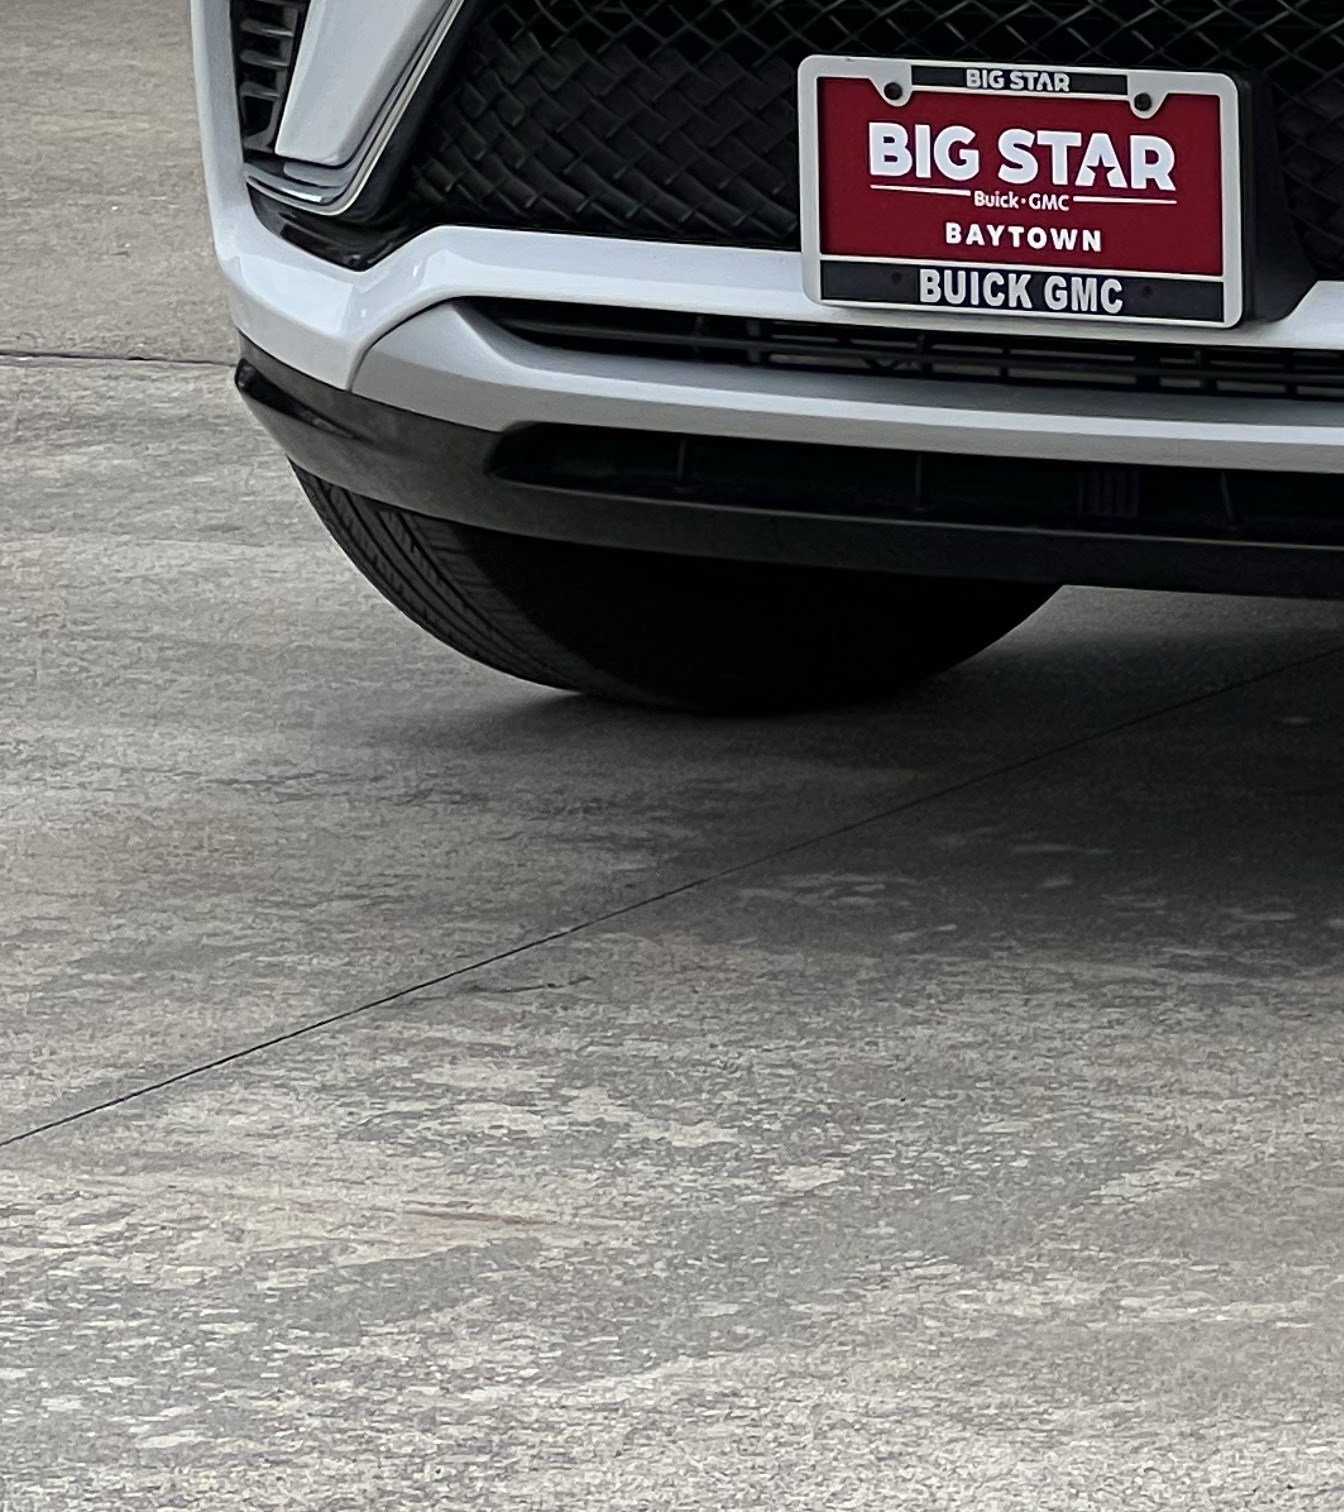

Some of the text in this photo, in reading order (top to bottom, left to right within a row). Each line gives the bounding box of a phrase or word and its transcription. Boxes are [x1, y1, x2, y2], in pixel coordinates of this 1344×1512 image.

[966, 68, 1070, 93] BIG STAR
[868, 121, 1177, 191] BIG STAR
[974, 191, 1070, 212] Buick GMC
[945, 222, 1102, 253] BAYTOWN
[919, 269, 1124, 314] BUICK GMC
